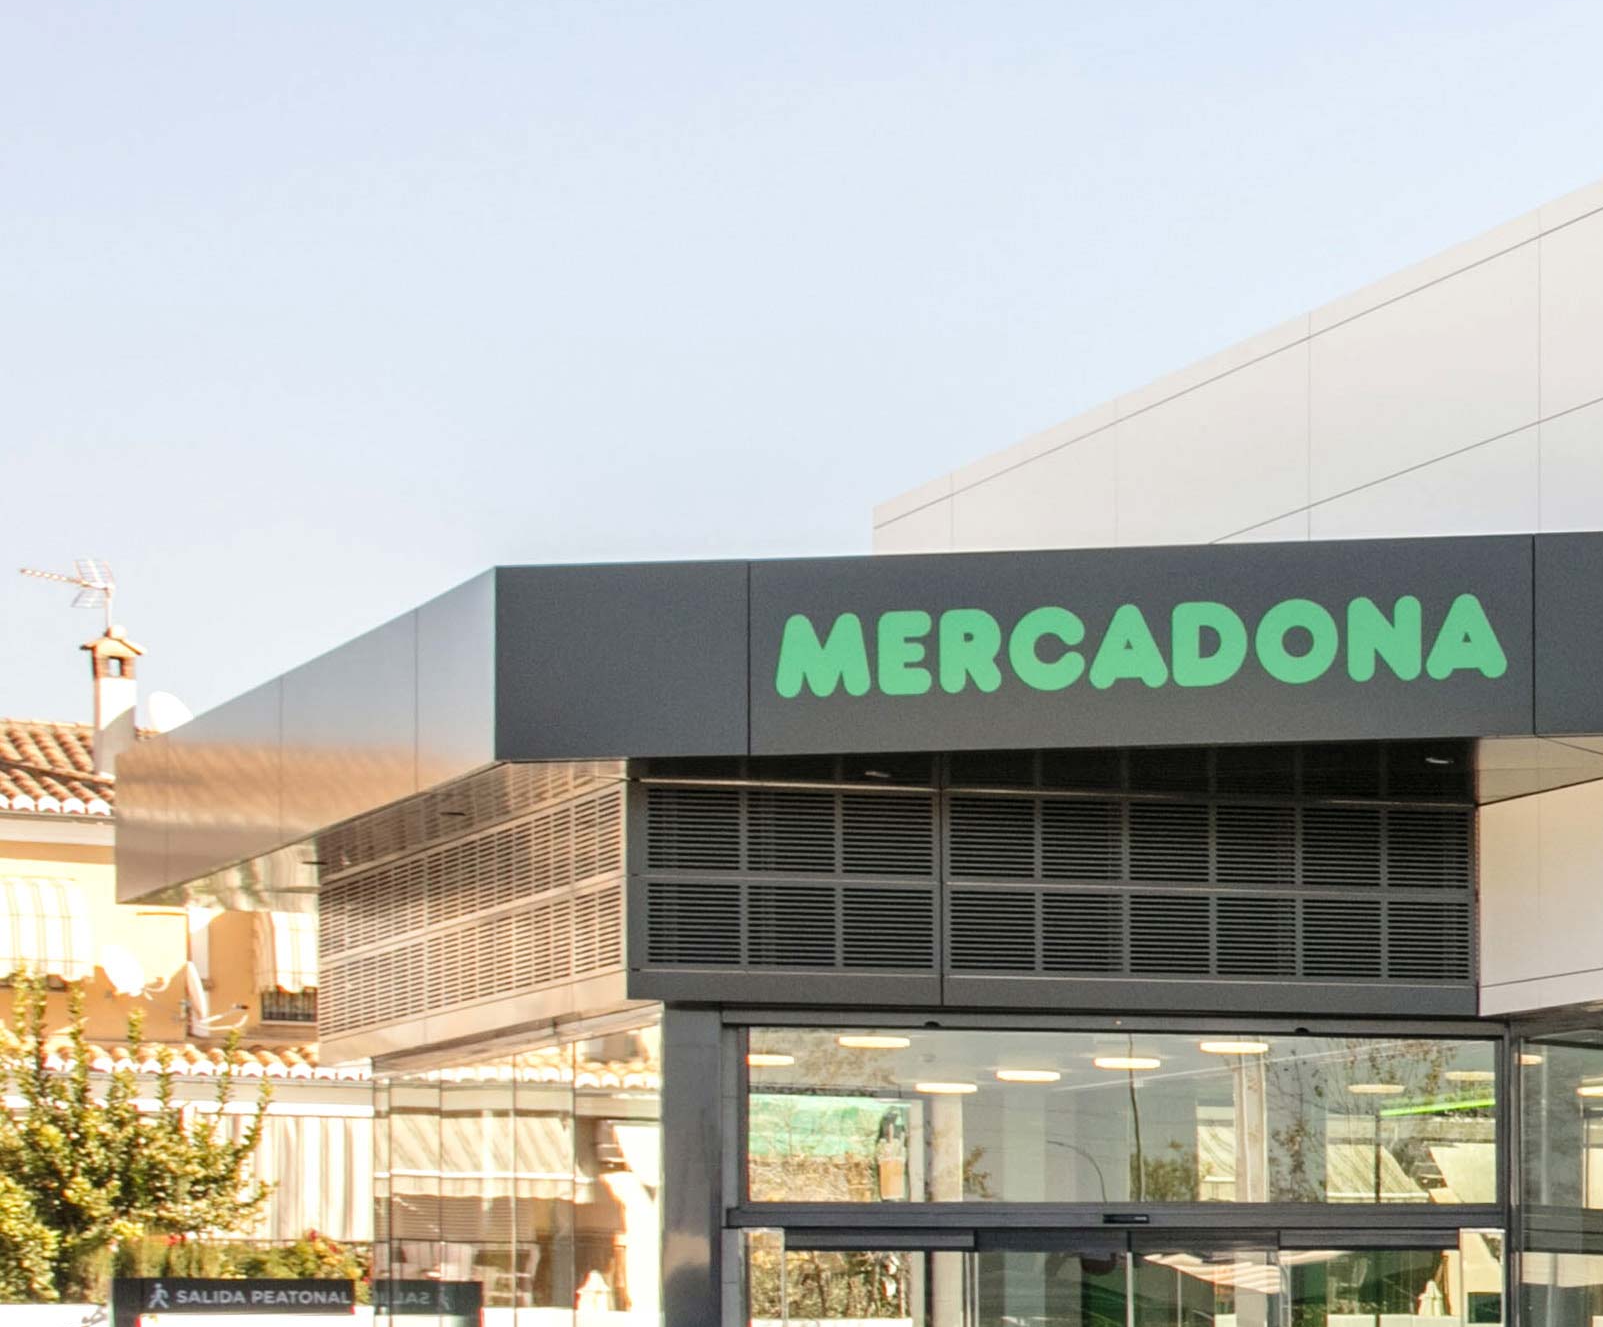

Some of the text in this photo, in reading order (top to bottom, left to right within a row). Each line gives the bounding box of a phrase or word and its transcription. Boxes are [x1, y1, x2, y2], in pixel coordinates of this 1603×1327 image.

[774, 593, 1508, 699] MERCADONA
[176, 1290, 352, 1305] SALIDA PEATONAL
